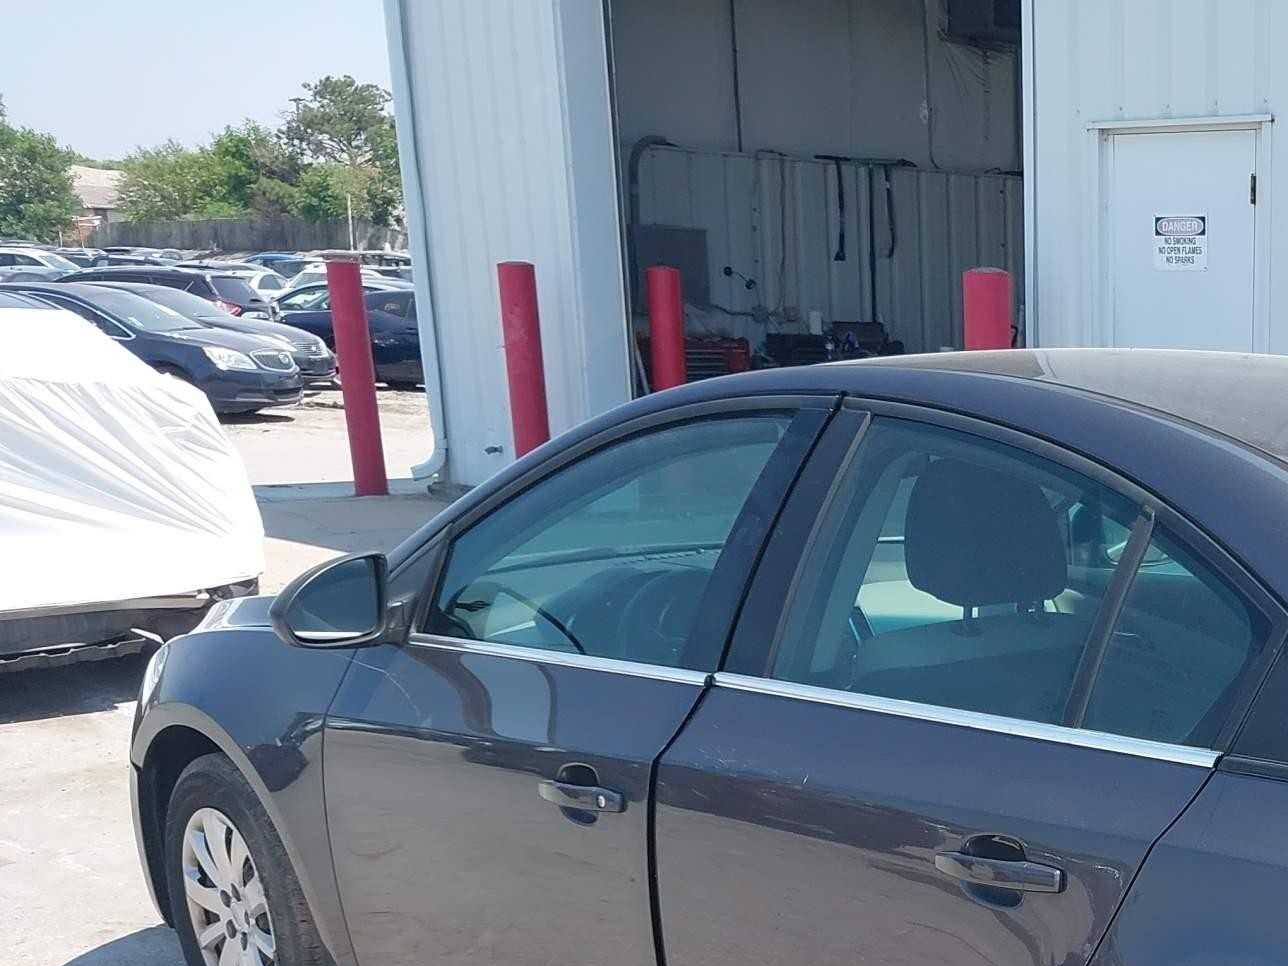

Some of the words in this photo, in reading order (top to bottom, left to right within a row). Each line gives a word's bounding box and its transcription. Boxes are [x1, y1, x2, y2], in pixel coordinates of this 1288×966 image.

[1162, 220, 1198, 232] DANGER
[1164, 237, 1172, 245] NO
[1172, 237, 1196, 245] SMOKING
[1158, 246, 1166, 255] NO
[1166, 246, 1181, 255] OPEN
[1181, 246, 1203, 255] FLAMES
[1165, 256, 1174, 264] NO
[1174, 256, 1195, 264] SPARKS
